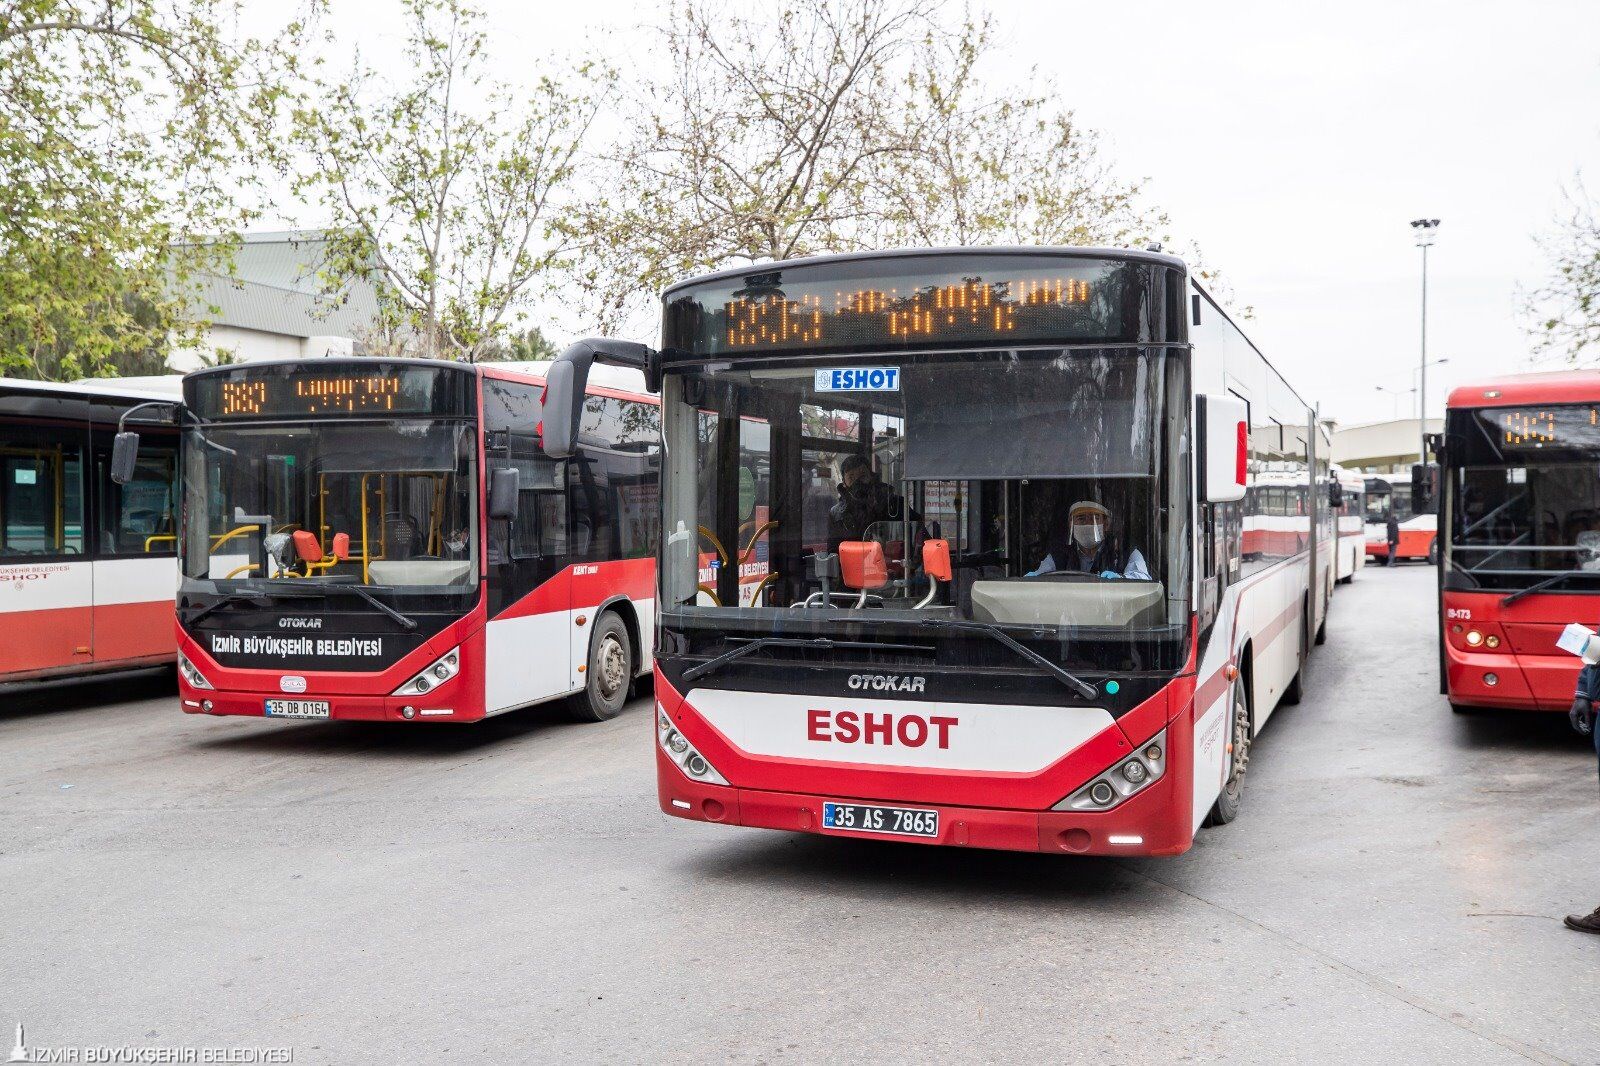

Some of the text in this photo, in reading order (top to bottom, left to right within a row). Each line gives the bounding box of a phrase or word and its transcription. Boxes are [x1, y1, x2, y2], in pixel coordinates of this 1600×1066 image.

[832, 370, 896, 389] ESHOT
[279, 618, 322, 628] OTOKAR
[212, 634, 382, 658] İZMİR BÜYÜKŞEHİR BELEDİYESİ
[848, 674, 926, 692] OTOKAR
[272, 702, 327, 715] 35 DB 0164
[807, 709, 959, 750] ESHOT
[835, 807, 935, 833] 35 AS 7865
